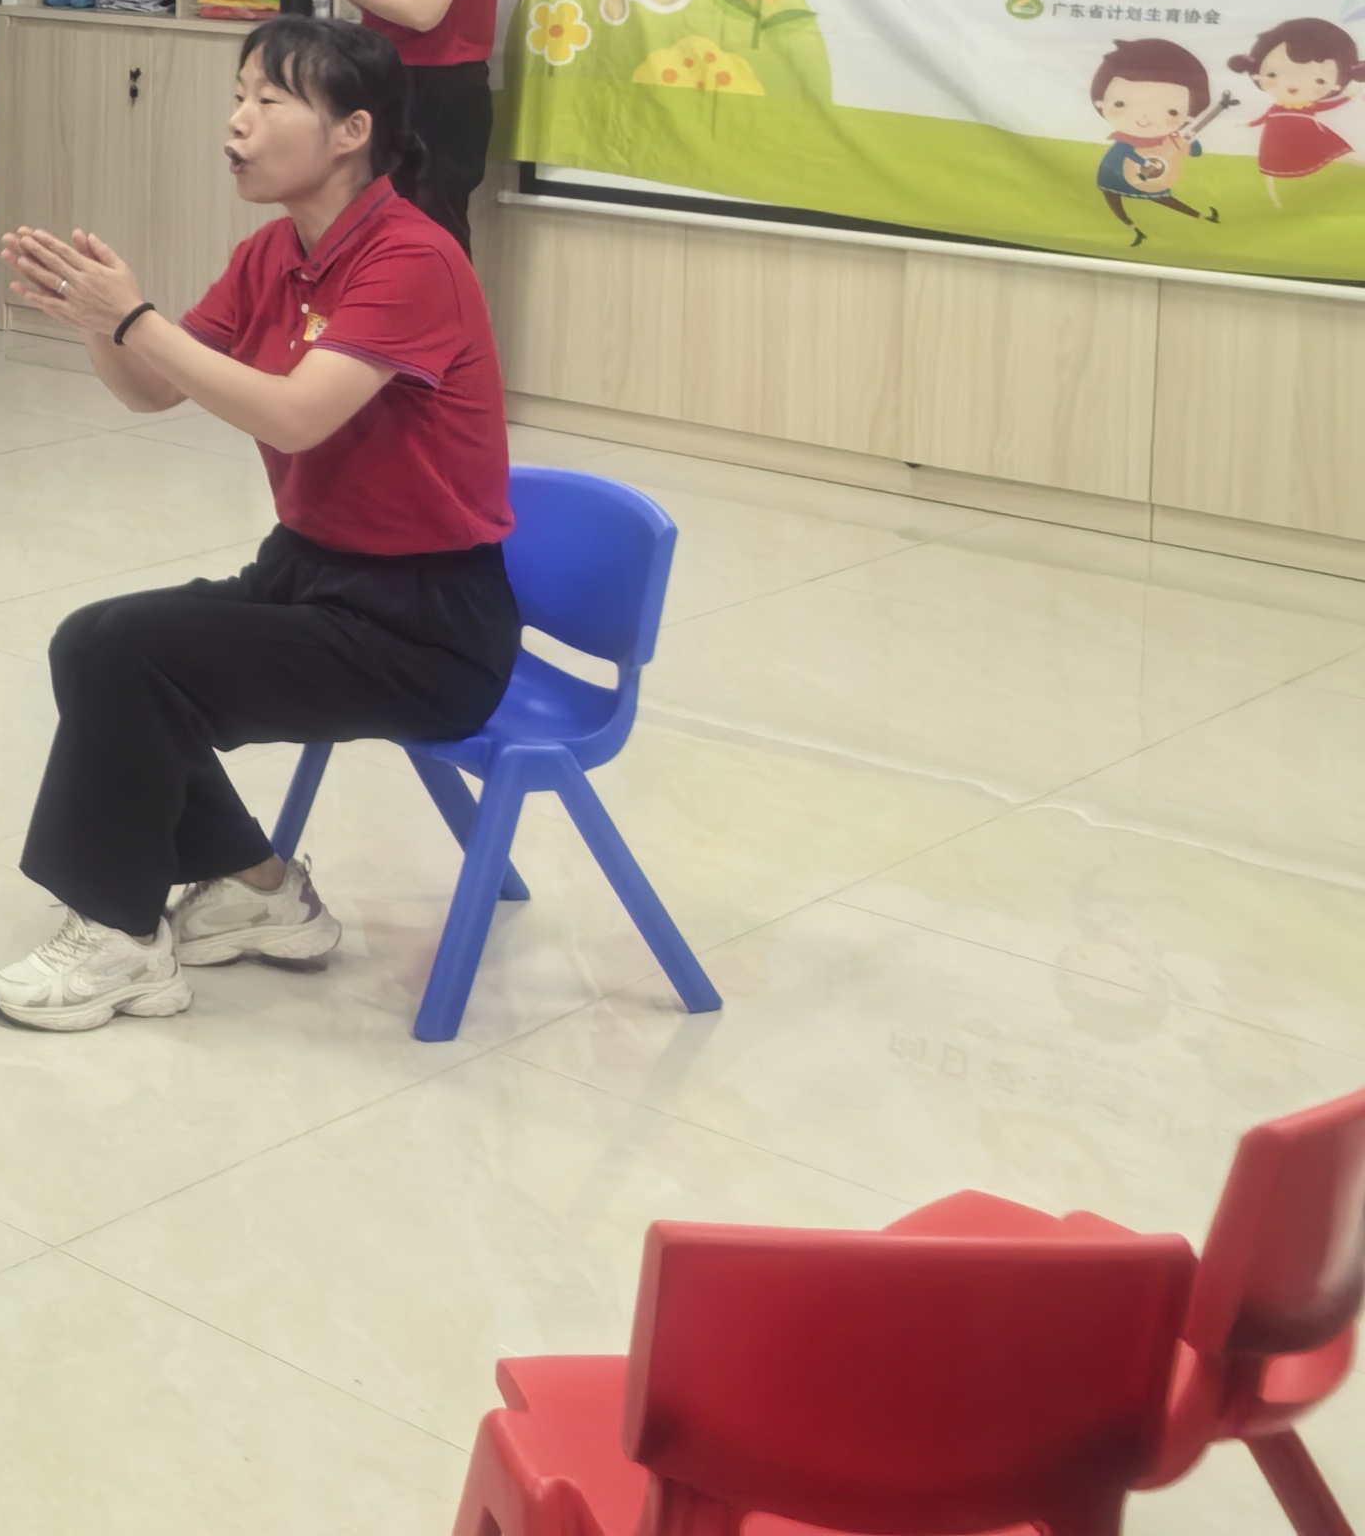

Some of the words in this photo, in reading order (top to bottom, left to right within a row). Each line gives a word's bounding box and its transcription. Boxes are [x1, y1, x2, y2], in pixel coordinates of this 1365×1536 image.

[1050, 1, 1223, 26] 广东省计划生育协会
